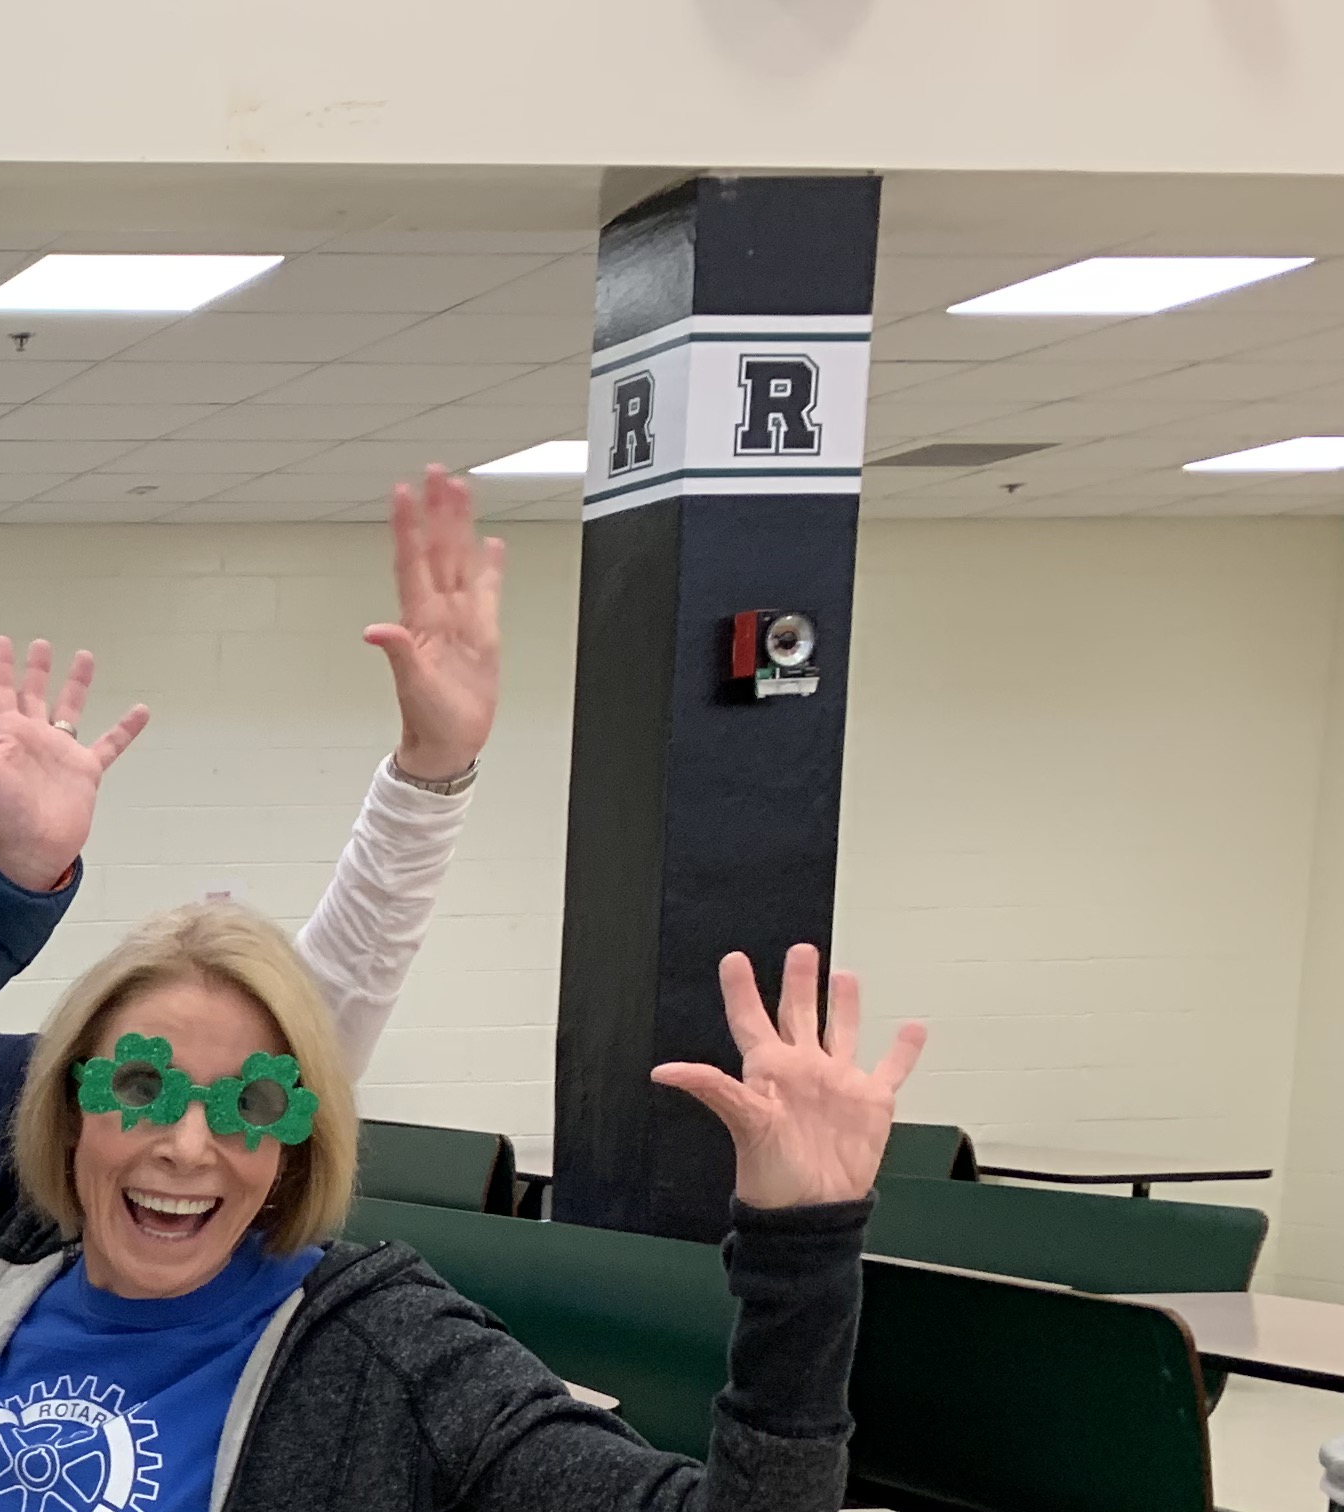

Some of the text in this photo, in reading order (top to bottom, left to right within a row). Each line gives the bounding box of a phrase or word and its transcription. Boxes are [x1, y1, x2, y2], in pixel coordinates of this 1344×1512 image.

[608, 368, 655, 479] R
[733, 353, 823, 457] R
[38, 1402, 108, 1427] ROTAR
